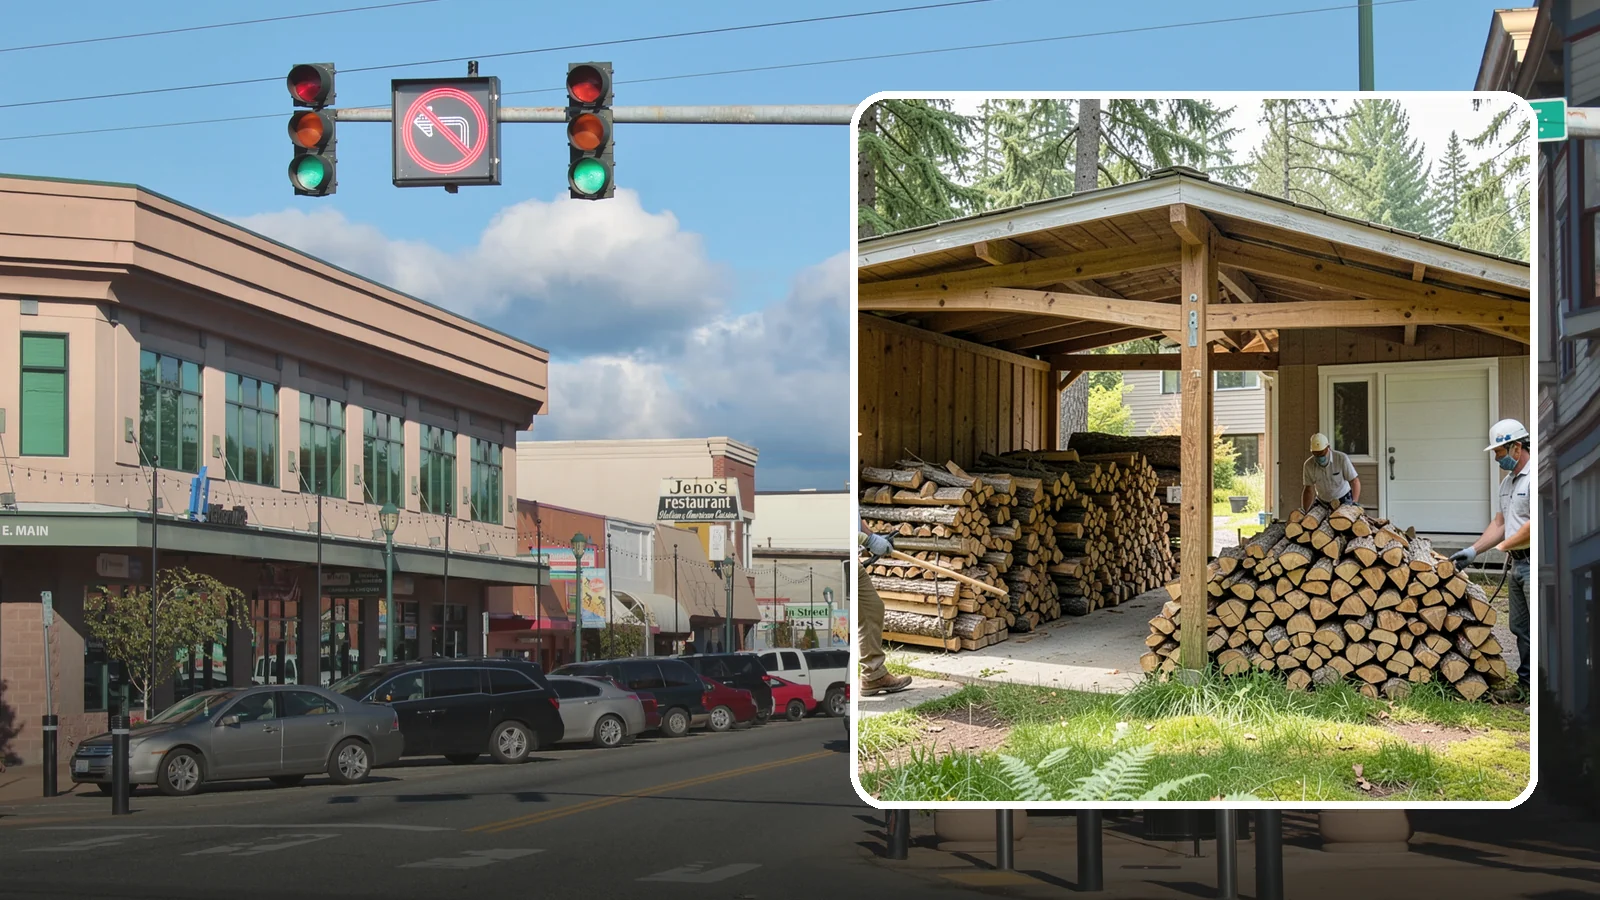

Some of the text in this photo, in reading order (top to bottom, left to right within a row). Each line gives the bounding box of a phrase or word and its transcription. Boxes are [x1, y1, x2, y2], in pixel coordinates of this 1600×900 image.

[669, 479, 727, 495] Jeno's
[665, 496, 731, 509] restaurant
[659, 510, 681, 519] Italian
[686, 509, 715, 519] American
[715, 509, 738, 519] Cuisine
[2, 525, 49, 536] E. MAIN
[797, 607, 828, 617] Street
